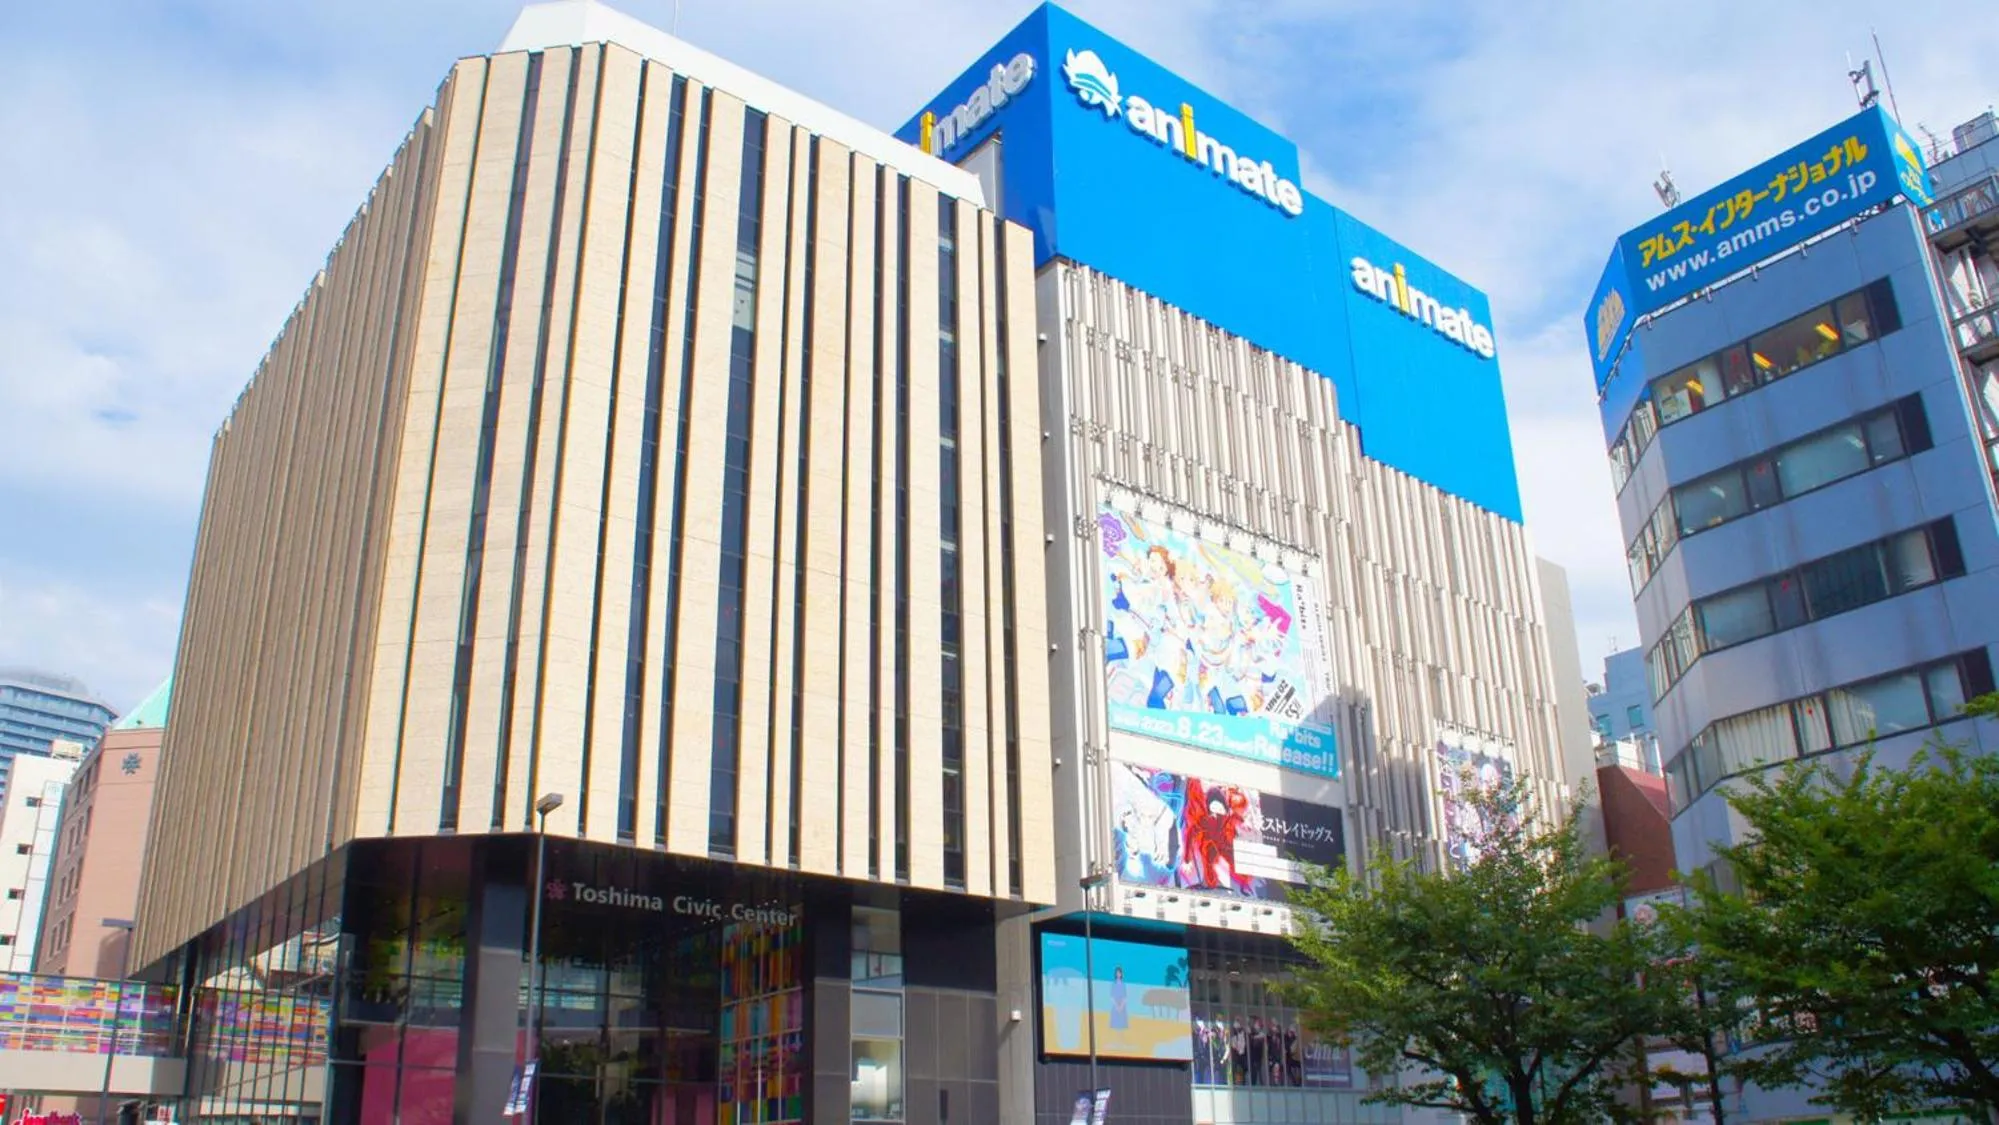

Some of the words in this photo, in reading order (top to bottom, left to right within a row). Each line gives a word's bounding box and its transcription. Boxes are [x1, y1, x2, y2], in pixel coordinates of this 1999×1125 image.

[1126, 96, 1304, 216] animate
[1638, 136, 1868, 267] アムス・インターナショナル
[1646, 170, 1877, 291] www.amms.co.jp
[1350, 256, 1496, 359] animate
[573, 881, 663, 911] Toshima
[673, 895, 722, 919] Civic
[731, 902, 797, 927] Center
